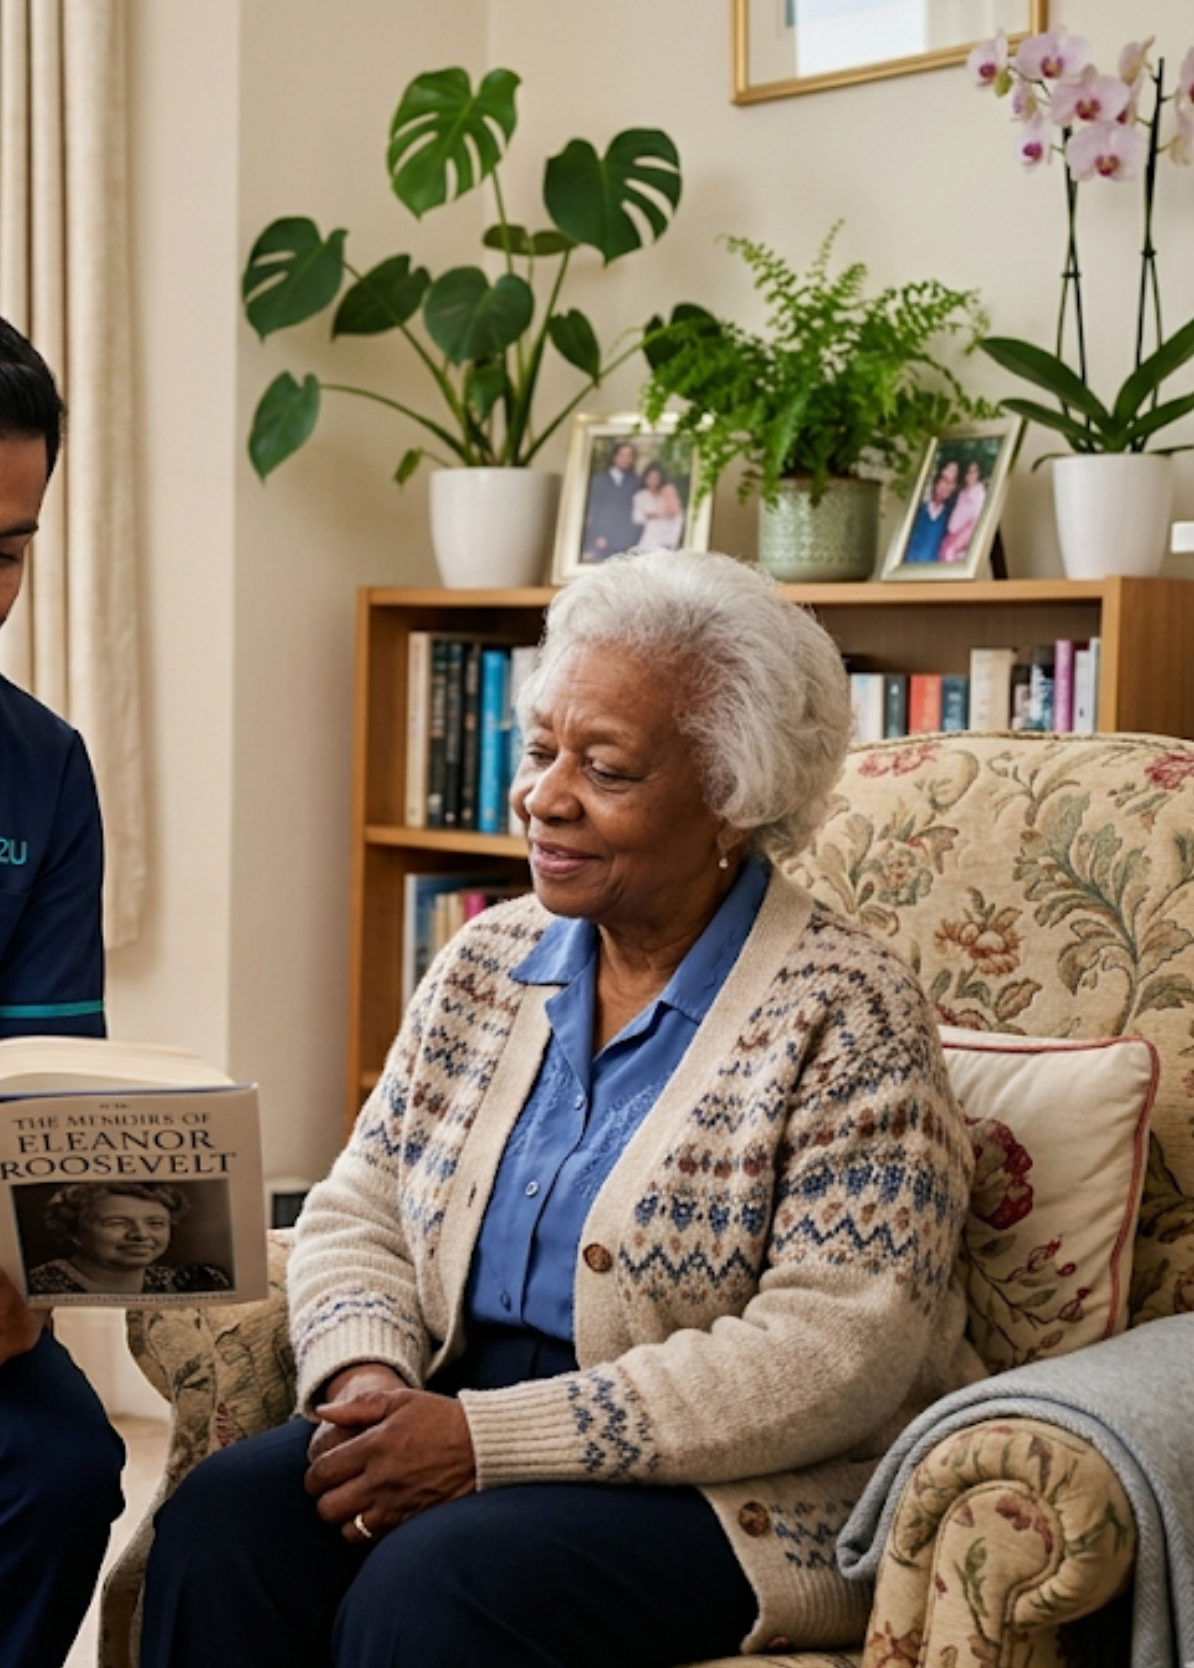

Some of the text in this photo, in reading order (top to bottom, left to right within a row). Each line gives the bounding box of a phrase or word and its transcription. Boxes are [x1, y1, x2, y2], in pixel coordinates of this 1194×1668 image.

[12, 1114, 59, 1131] THE
[182, 1112, 211, 1126] OF
[17, 1129, 216, 1154] ELEANOR
